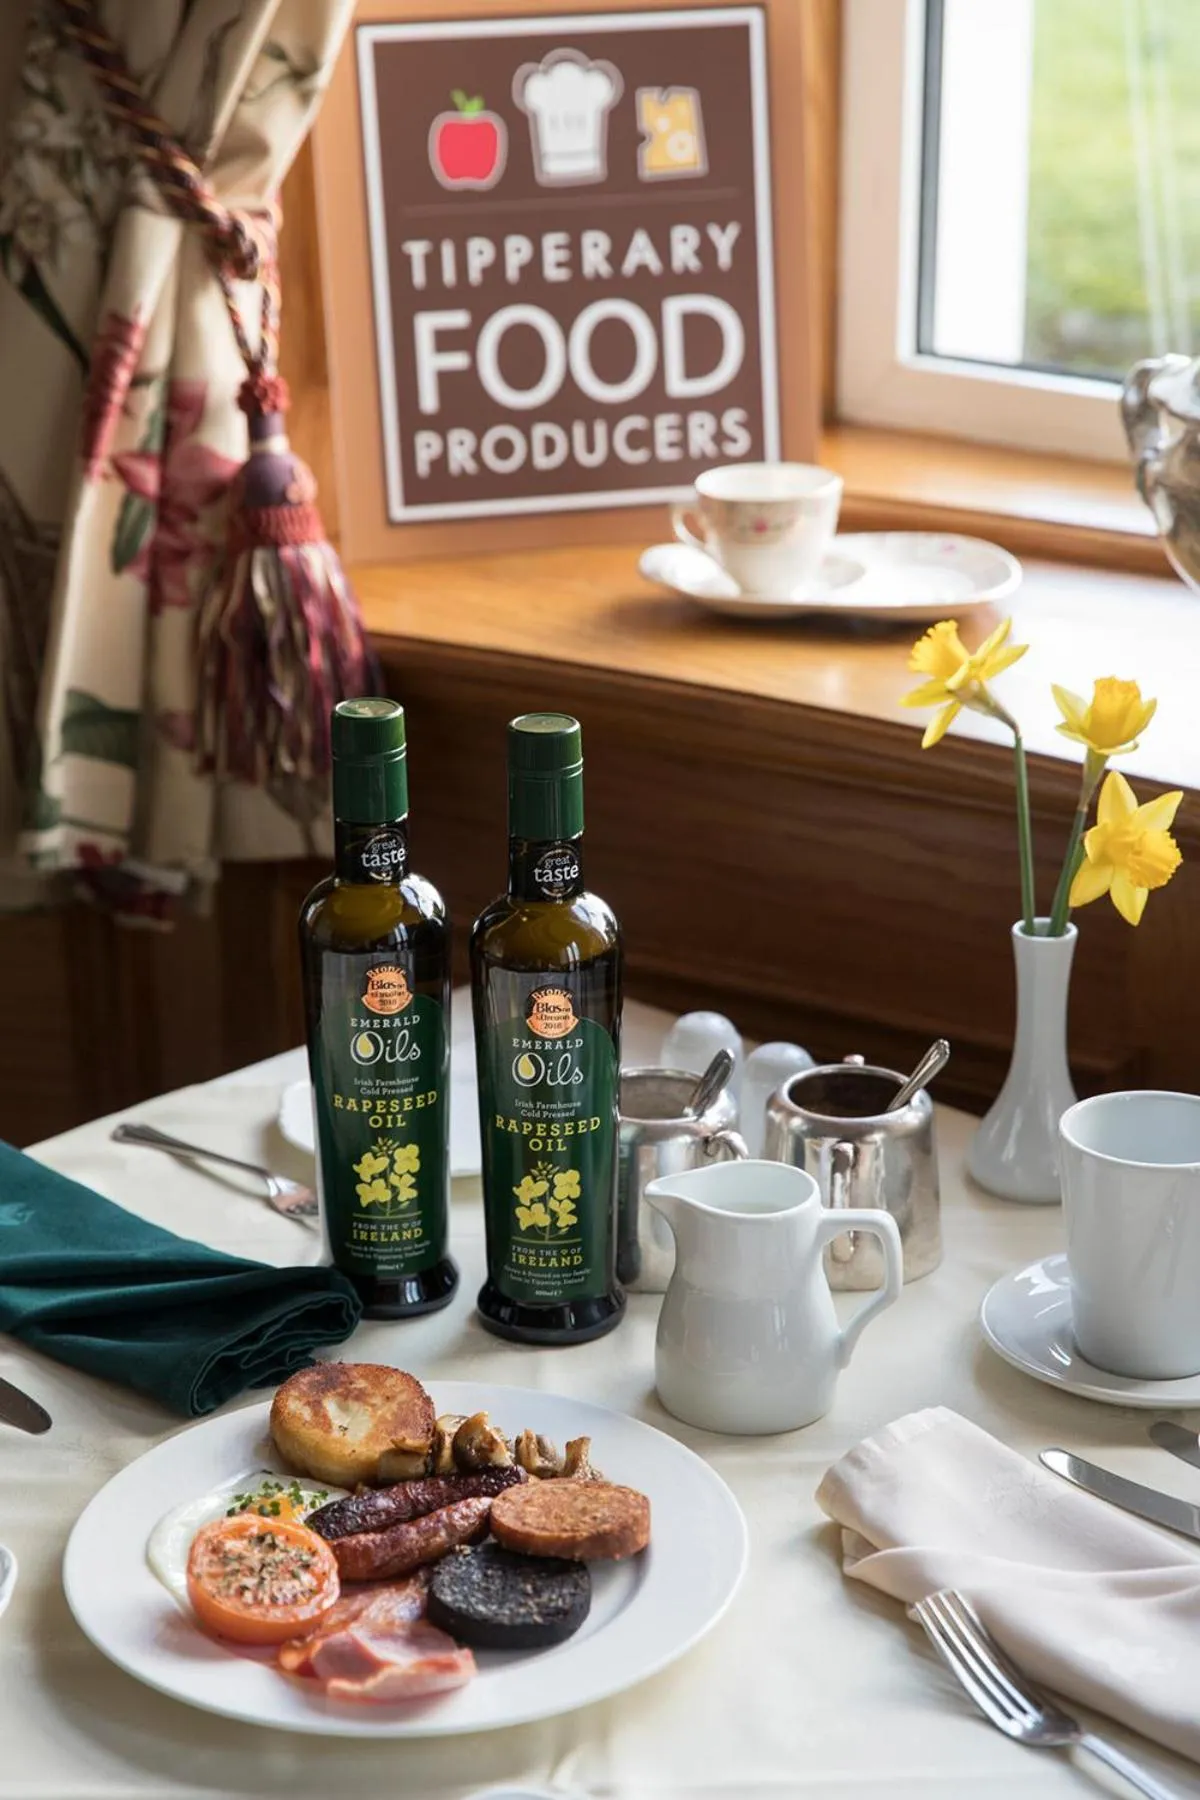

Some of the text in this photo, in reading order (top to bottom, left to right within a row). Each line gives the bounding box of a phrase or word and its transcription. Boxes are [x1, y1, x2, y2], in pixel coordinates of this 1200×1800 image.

[402, 221, 740, 290] TIPPERARY
[413, 294, 745, 414] FOOD
[414, 408, 752, 478] PRODUCERS
[361, 848, 406, 867] taste
[534, 865, 579, 882] taste
[350, 1015, 420, 1028] EMERALD
[350, 1029, 421, 1066] Oils
[512, 1038, 584, 1050] EMERALD
[512, 1052, 584, 1087] Oils
[333, 1090, 437, 1113] RAPESEED
[369, 1114, 407, 1128] OIL
[496, 1114, 601, 1137] RAPESEED
[529, 1138, 567, 1152] OIL
[352, 1228, 423, 1242] IRELAND
[512, 1253, 583, 1267] IRELAND
